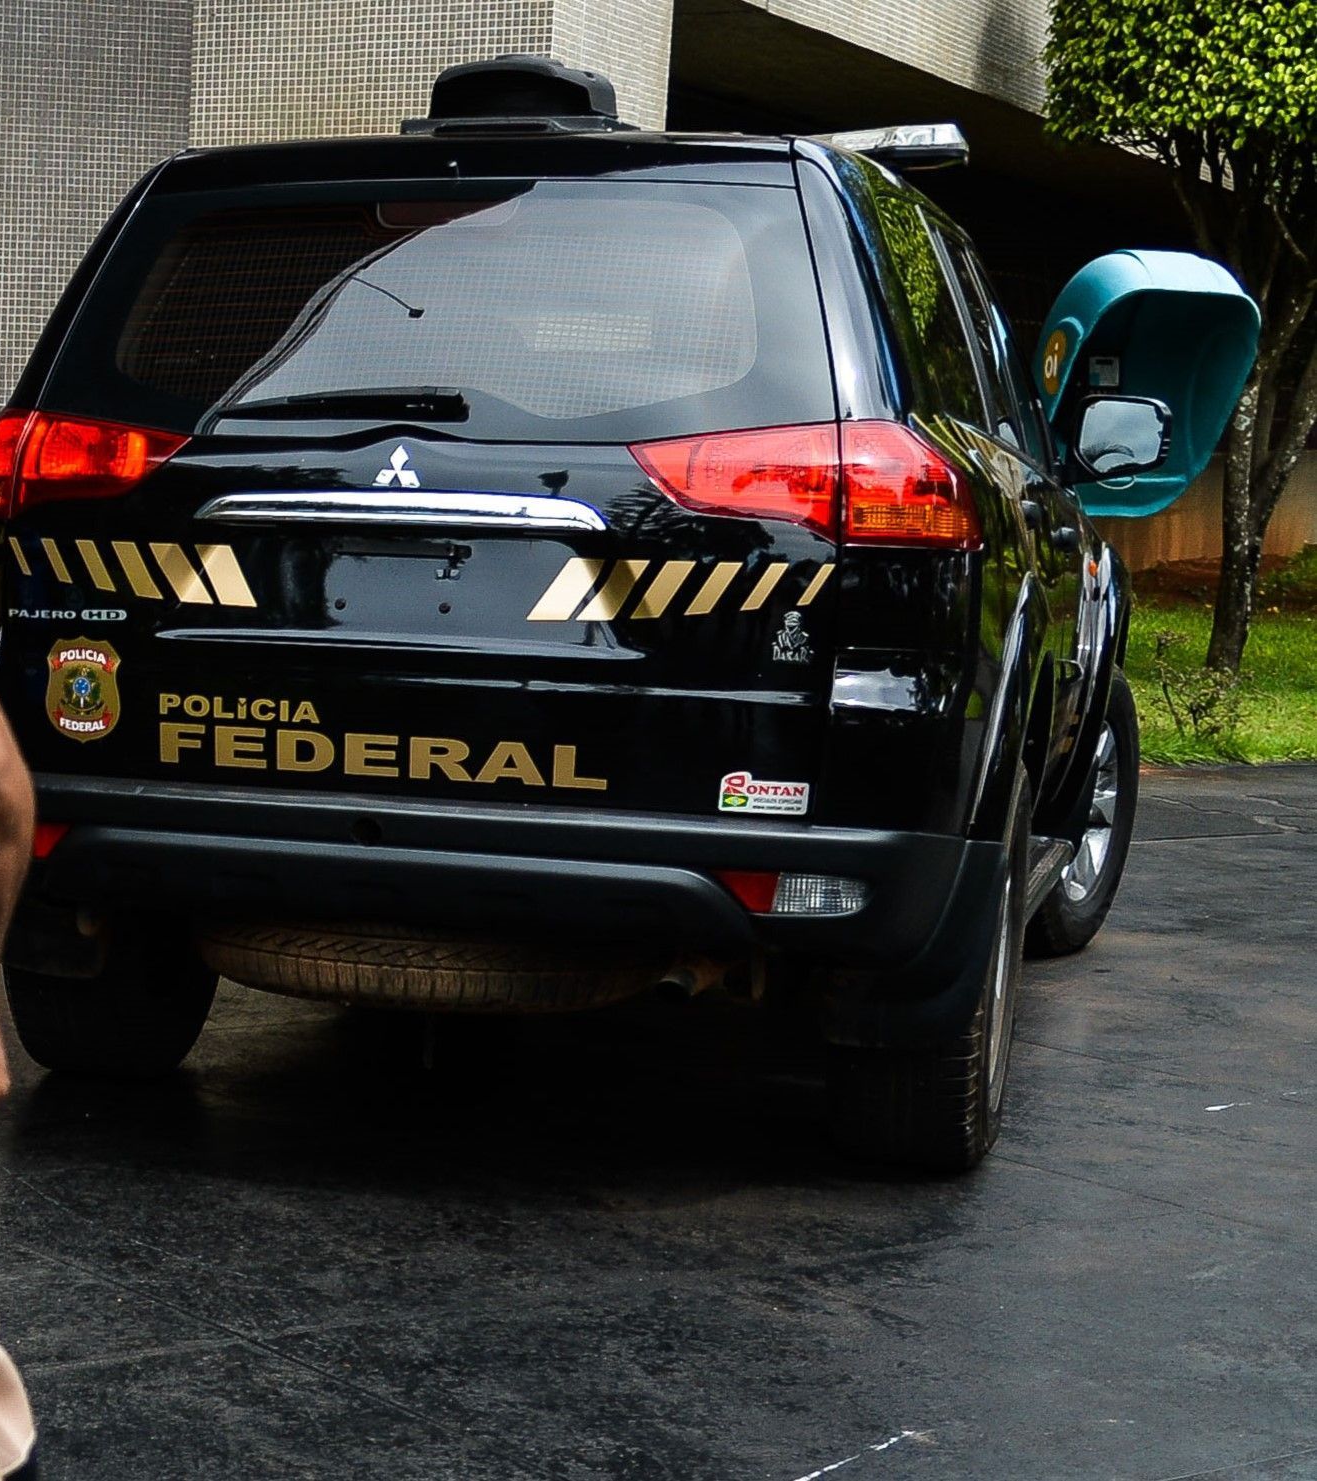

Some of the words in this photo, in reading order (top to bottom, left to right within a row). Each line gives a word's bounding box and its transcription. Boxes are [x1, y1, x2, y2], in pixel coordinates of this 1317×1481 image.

[1044, 342, 1059, 379] oi
[8, 608, 77, 619] PAJERO
[84, 609, 123, 620] HD
[772, 645, 810, 663] DAKAR
[59, 717, 106, 732] FEDERAL
[159, 722, 608, 790] FEDERAL
[724, 775, 805, 797] RONTAN
